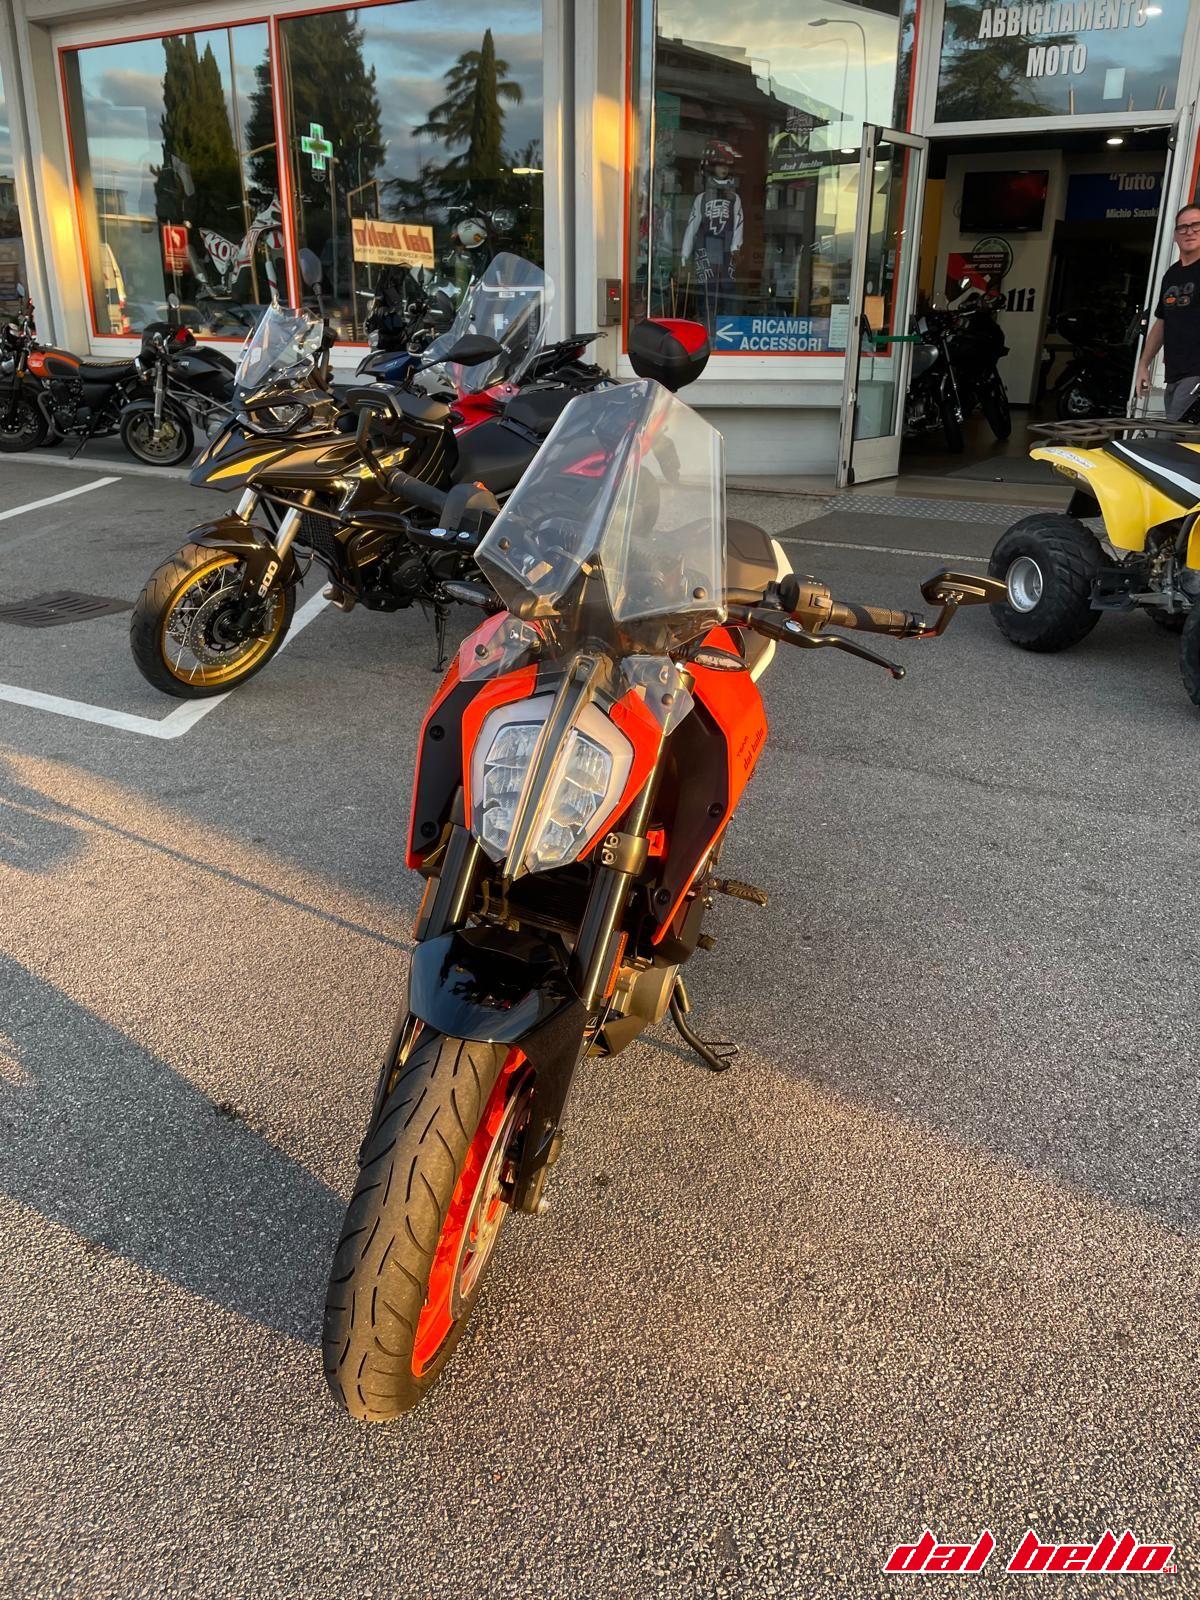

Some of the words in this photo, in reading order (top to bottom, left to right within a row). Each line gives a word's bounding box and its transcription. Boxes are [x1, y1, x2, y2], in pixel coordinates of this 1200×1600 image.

[978, 0, 1148, 39] ABBIGLIAMENTO
[1026, 44, 1088, 77] MOTO
[751, 319, 812, 334] RICAMBI
[740, 336, 822, 352] ACCESSORI
